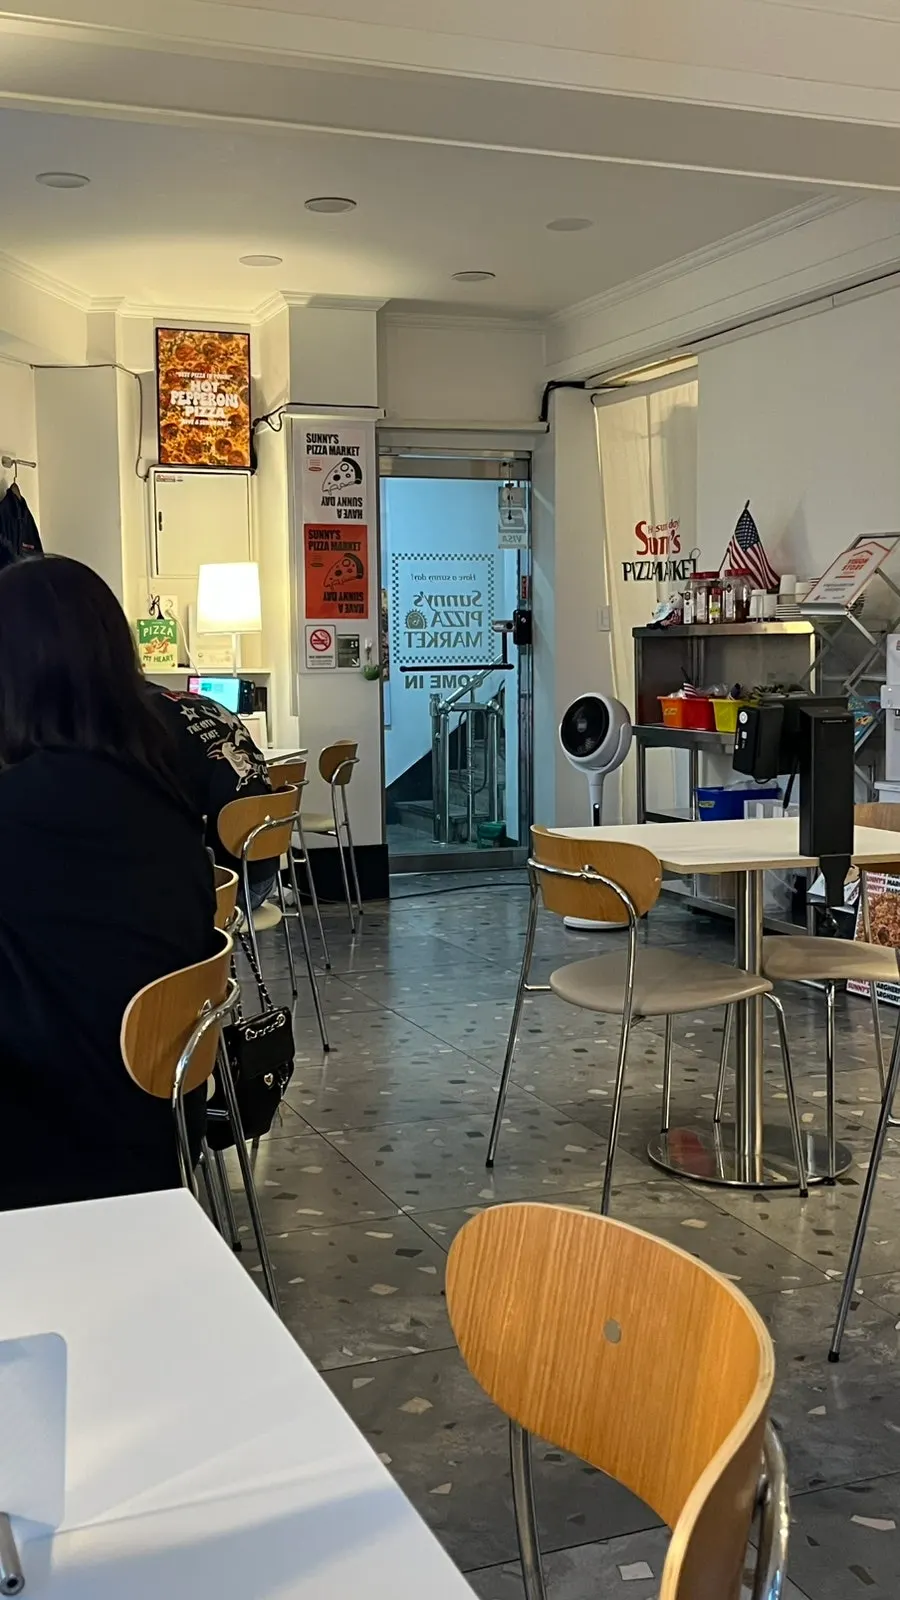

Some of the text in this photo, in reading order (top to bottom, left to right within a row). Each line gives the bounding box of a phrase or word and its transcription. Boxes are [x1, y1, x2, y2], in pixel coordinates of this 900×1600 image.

[190, 380, 219, 393] HOT
[170, 390, 239, 409] PEPPERONI
[185, 405, 226, 419] PIZZA
[306, 433, 339, 444] SUNNY'S
[306, 445, 360, 456] PIZZA MARKET
[321, 496, 363, 507] DAY SUNNY
[336, 508, 363, 519] A HAVE
[308, 529, 340, 540] SUNNY'S
[308, 541, 361, 551] PIZZA MARKET
[323, 592, 364, 602] DAY SUNNY
[344, 603, 364, 614] HAVE
[143, 625, 174, 637] PIZZA
[186, 723, 203, 734] THE
[200, 730, 220, 743] STATE
